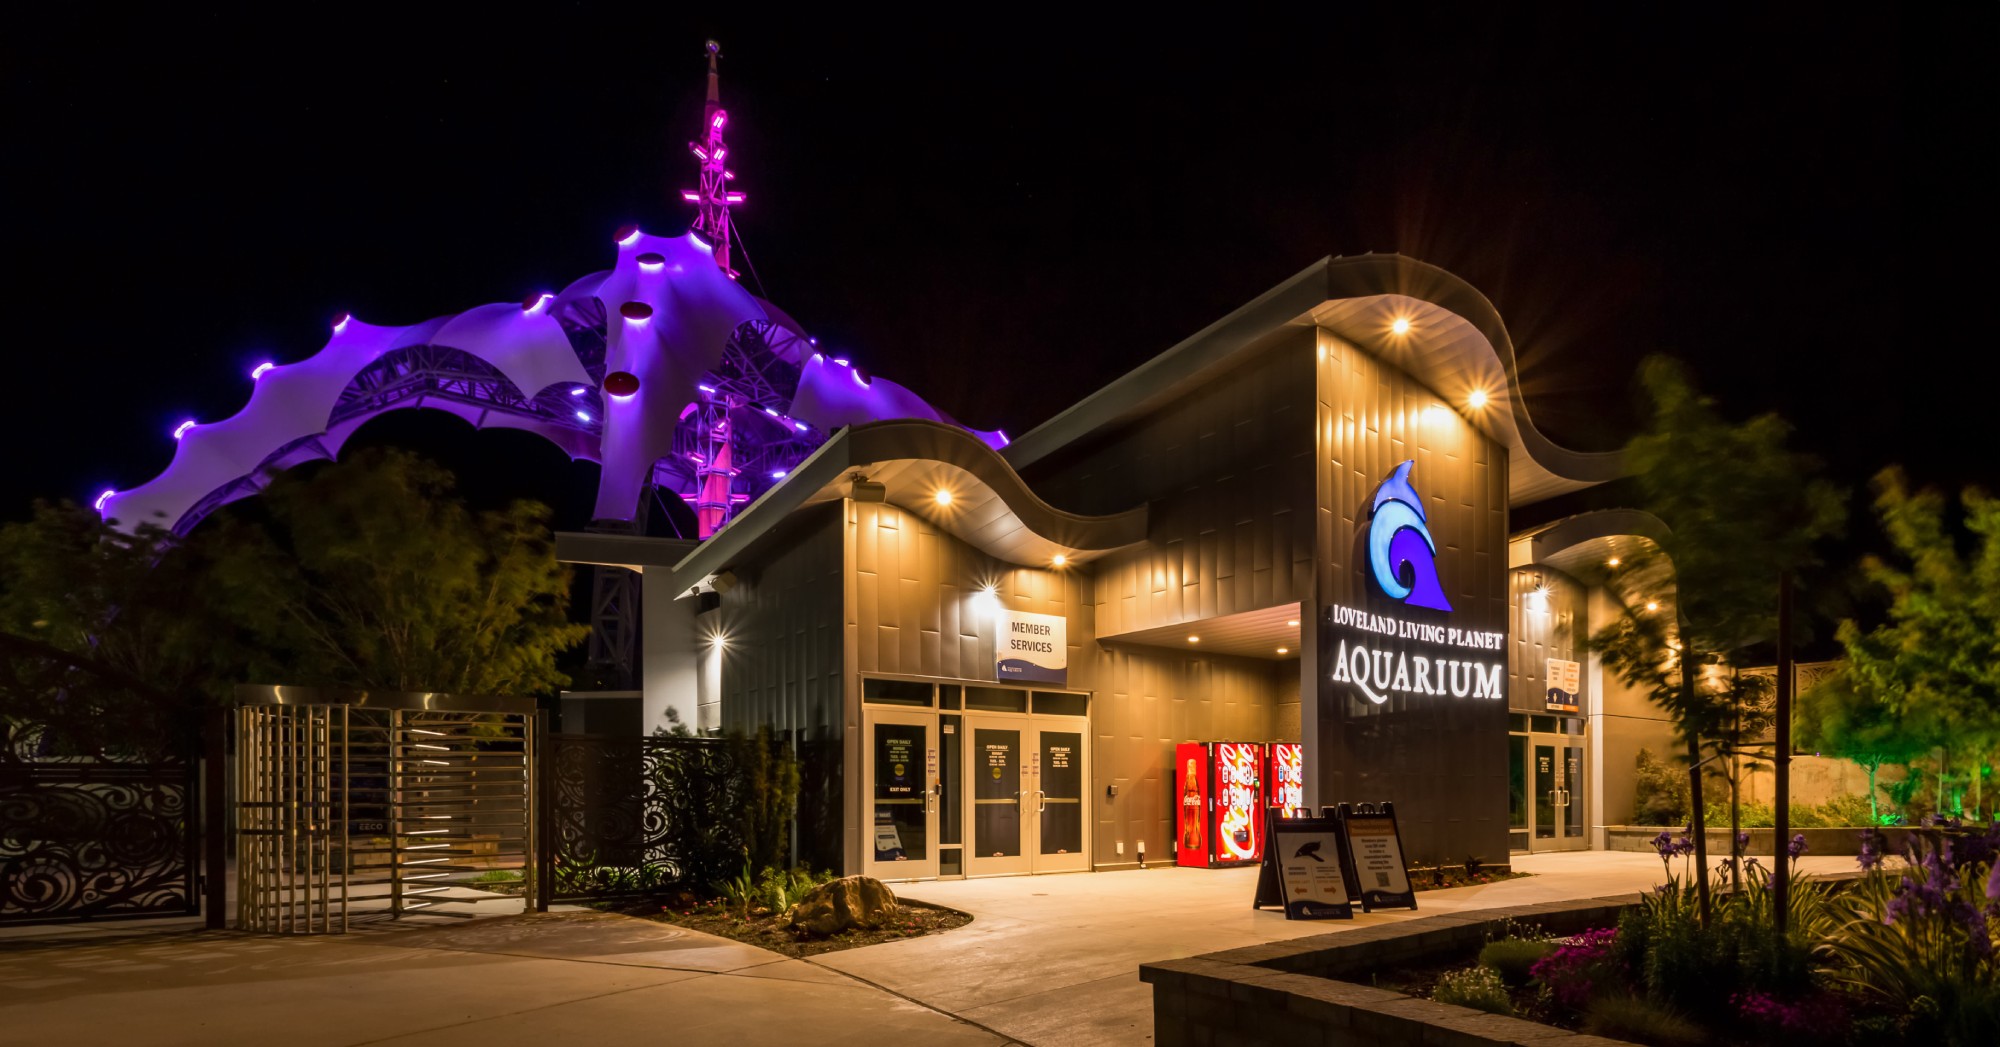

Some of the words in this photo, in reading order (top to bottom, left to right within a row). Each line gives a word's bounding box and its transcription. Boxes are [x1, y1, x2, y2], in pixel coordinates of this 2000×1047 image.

[1011, 621, 1051, 636] MEMBER
[1333, 604, 1396, 635] LOVELAND
[1399, 620, 1445, 644] LIVING
[1447, 628, 1503, 650] PLANET
[1010, 639, 1053, 653] SERVICES
[1332, 639, 1503, 704] AQUARIUM
